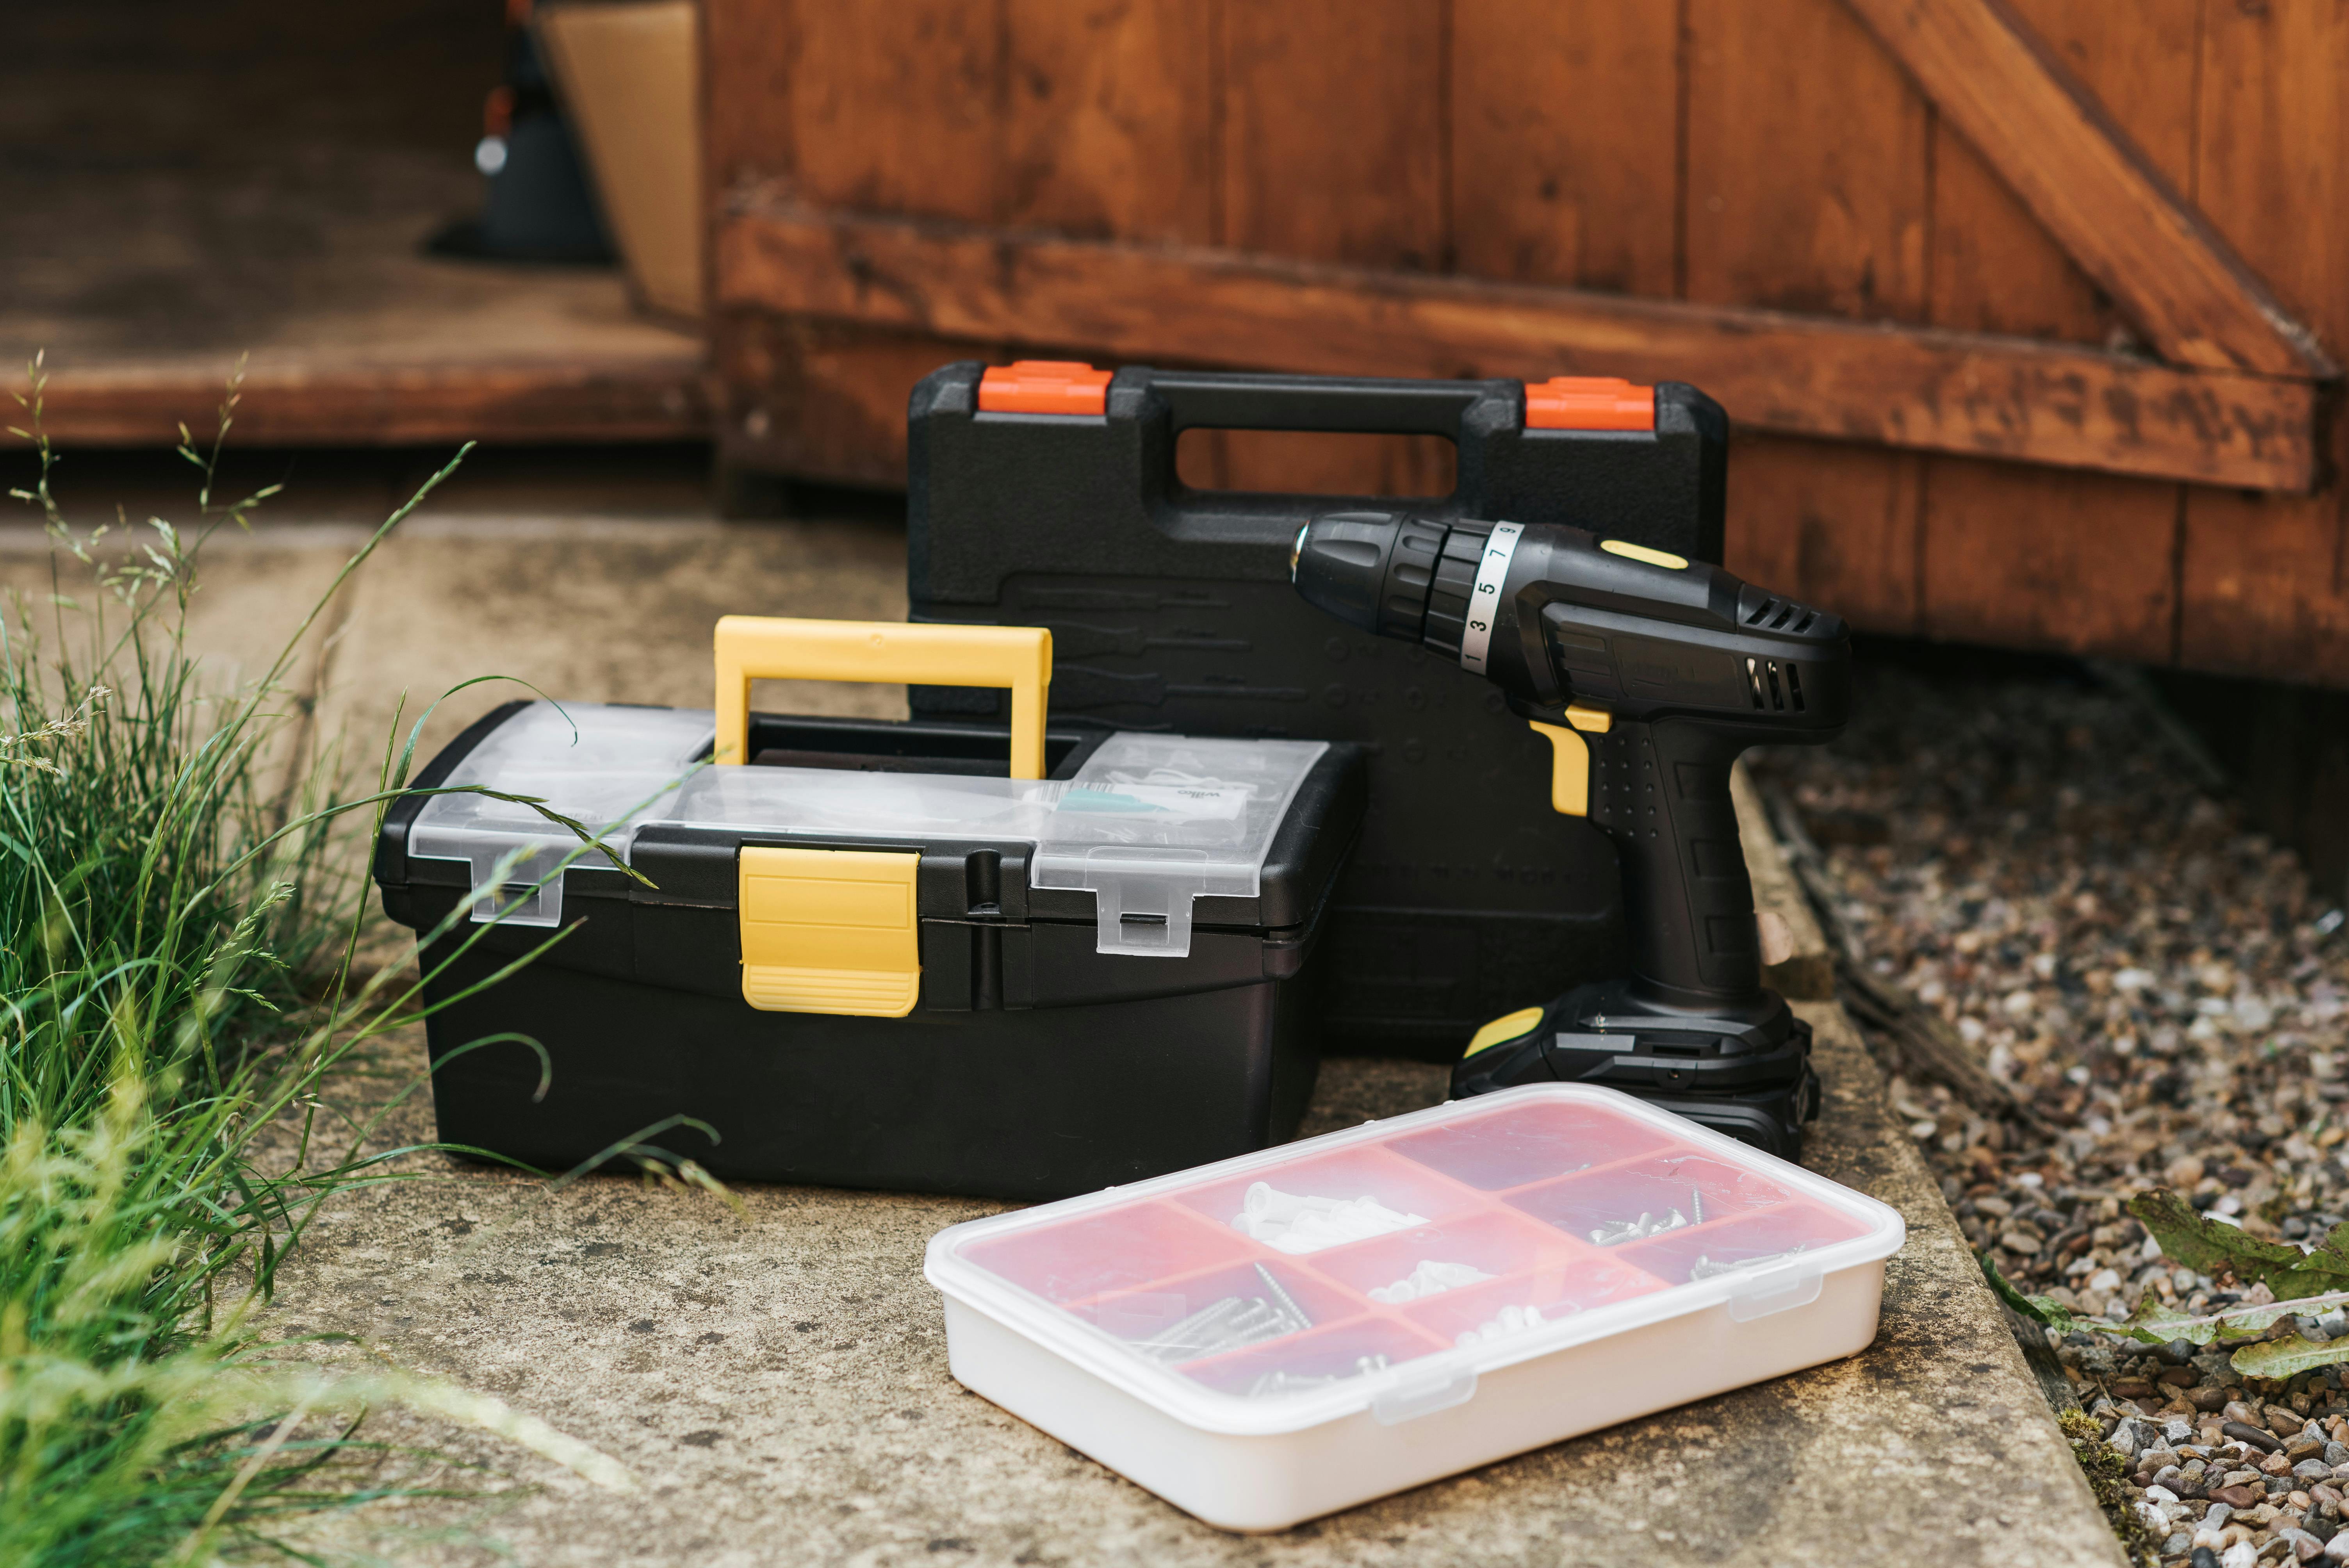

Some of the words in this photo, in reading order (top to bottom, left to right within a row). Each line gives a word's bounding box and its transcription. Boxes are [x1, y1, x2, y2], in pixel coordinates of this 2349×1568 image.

[1470, 620, 1486, 632] 3
[1478, 583, 1495, 594] 5
[1489, 549, 1506, 558] 7
[1177, 790, 1220, 798] wilko
